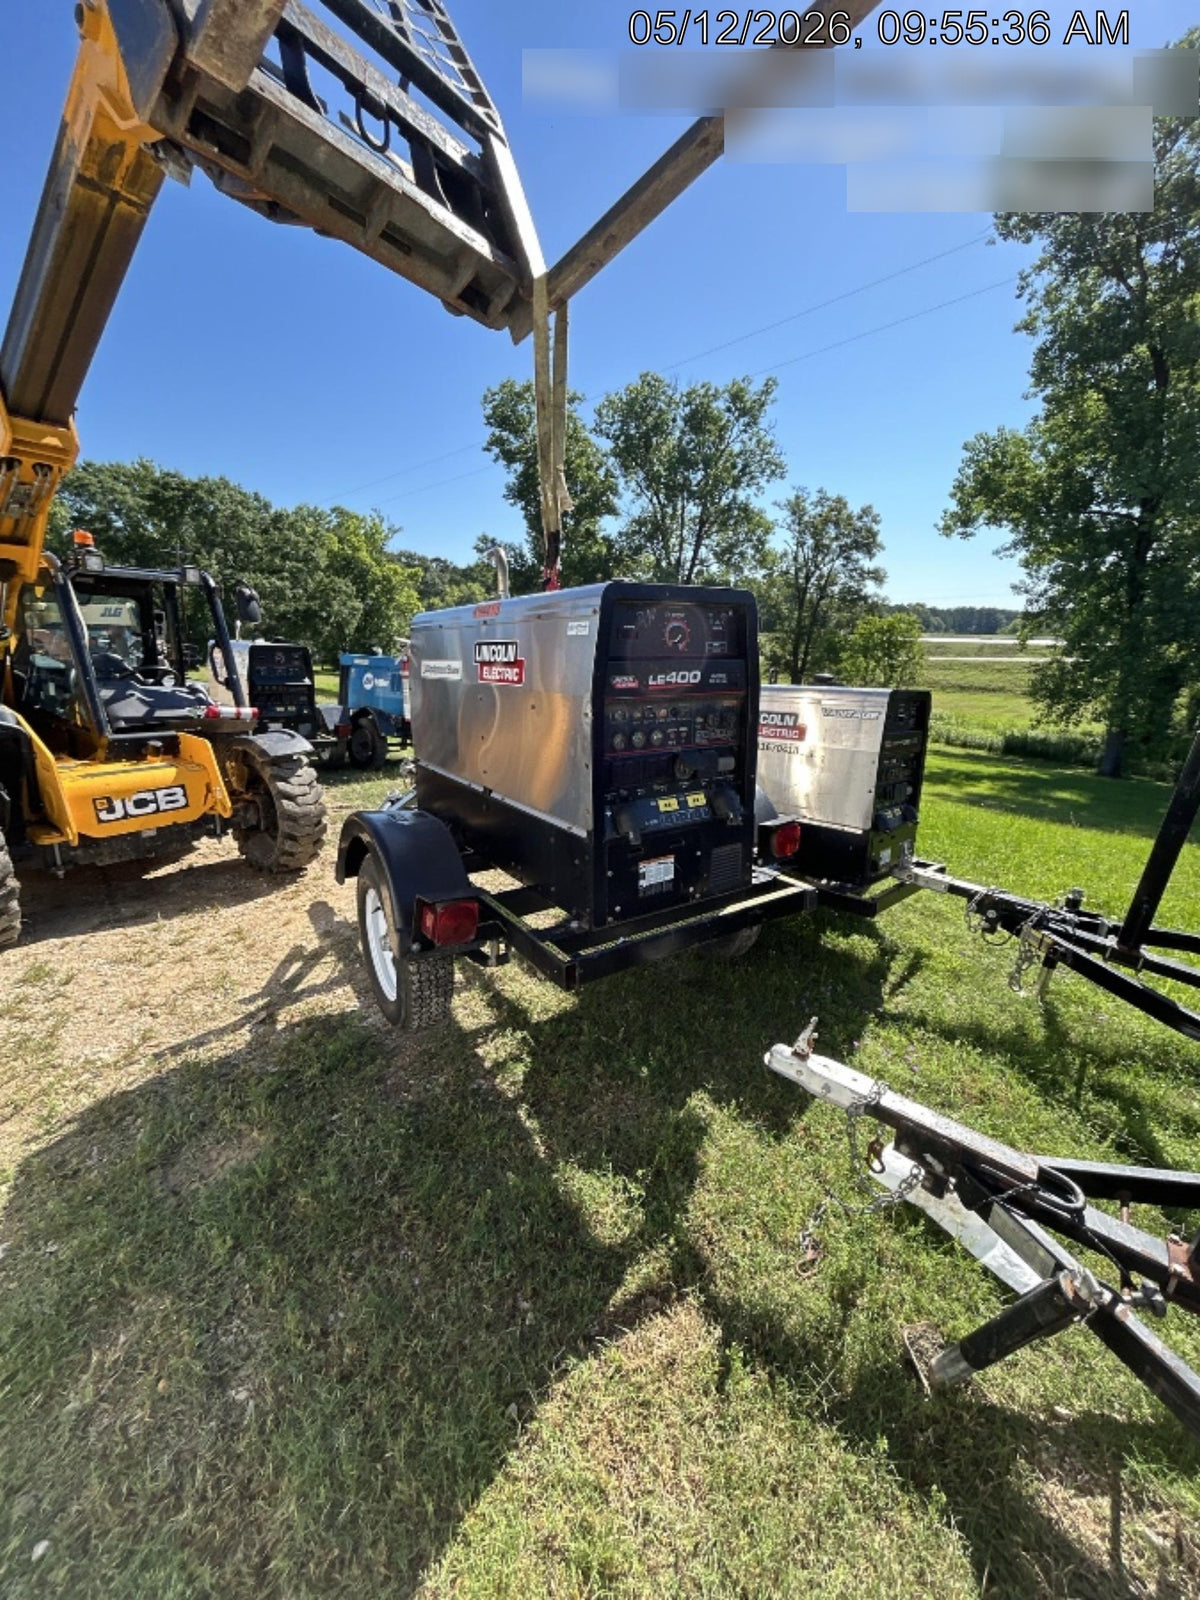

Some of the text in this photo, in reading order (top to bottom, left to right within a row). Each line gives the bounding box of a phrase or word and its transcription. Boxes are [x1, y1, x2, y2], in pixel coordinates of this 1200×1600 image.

[100, 607, 123, 618] JLG
[475, 644, 517, 662] LINCOLN
[482, 665, 520, 682] ELECTRIC
[648, 670, 702, 686] LE400
[760, 712, 796, 726] COLN
[95, 785, 190, 821] JCB
